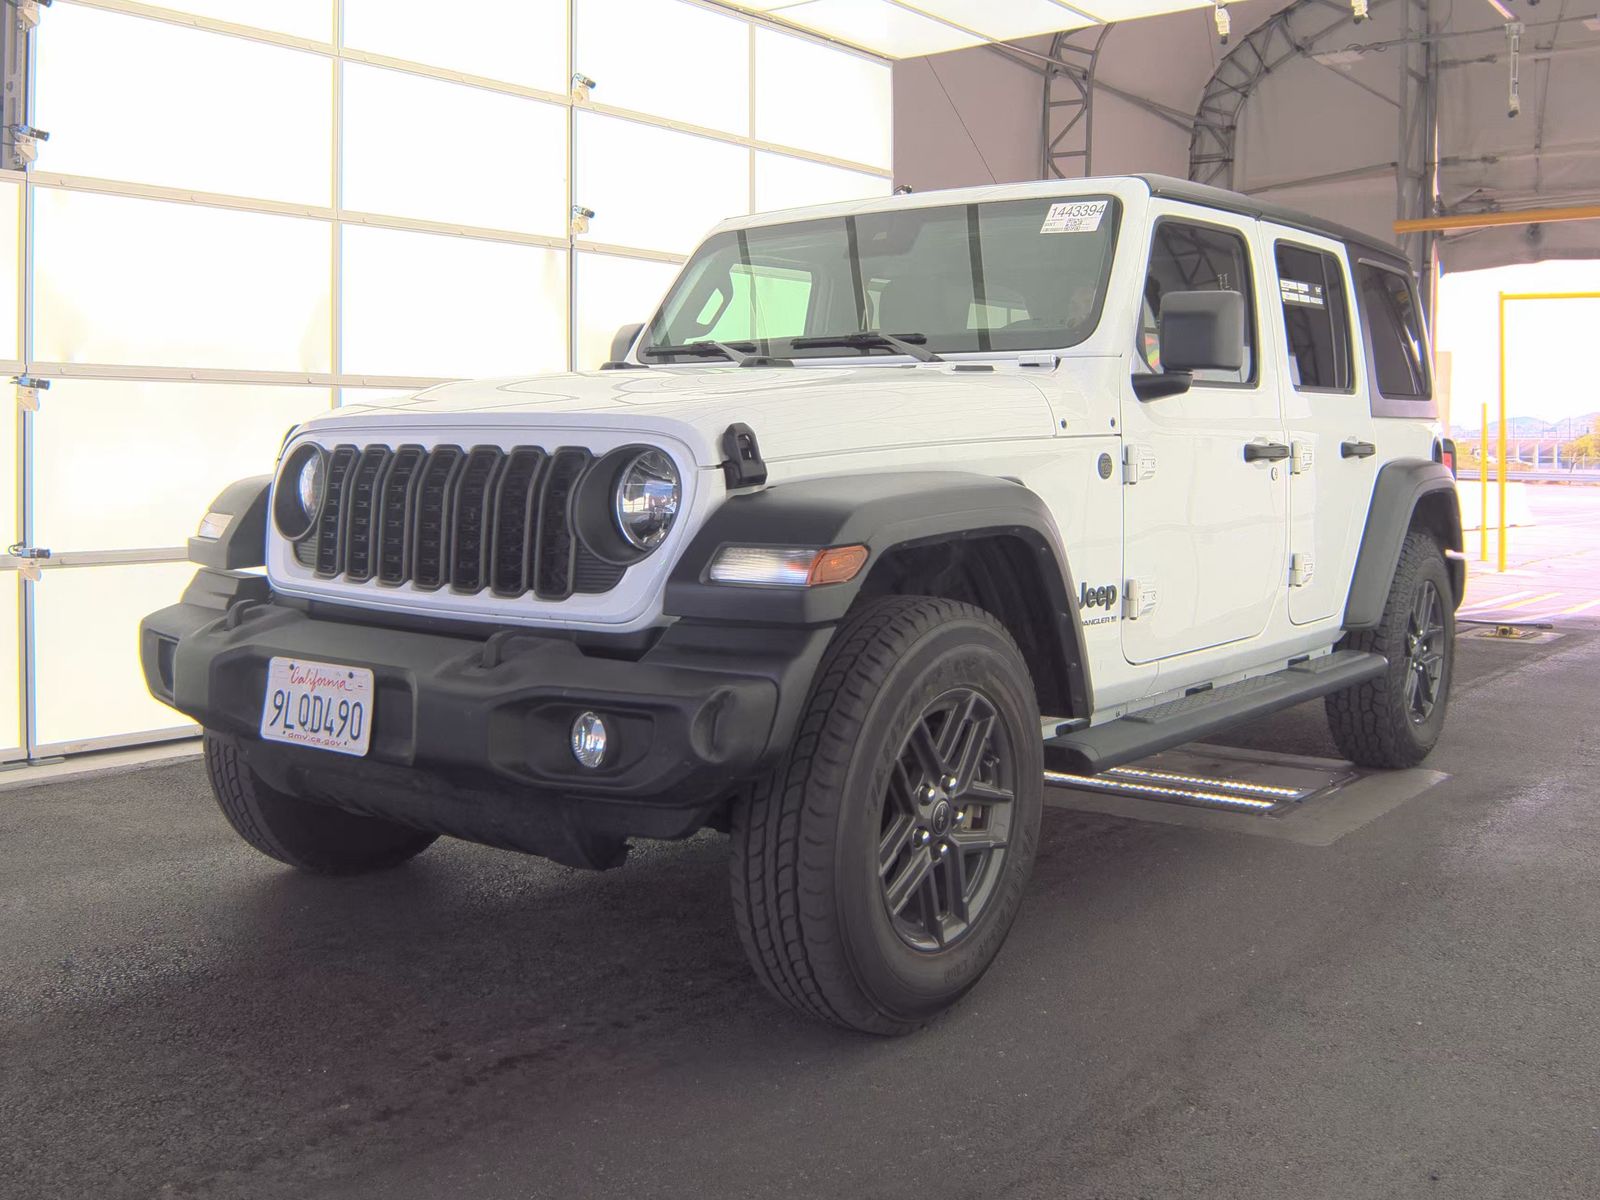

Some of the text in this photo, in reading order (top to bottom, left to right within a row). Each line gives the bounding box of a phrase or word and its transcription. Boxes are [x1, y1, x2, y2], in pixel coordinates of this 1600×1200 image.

[1051, 204, 1106, 218] 1443394
[1079, 581, 1118, 611] Jeep
[1081, 616, 1110, 626] ANGLER
[290, 666, 353, 692] California
[269, 689, 364, 741] 9LQD490
[287, 731, 343, 747] dmv.ca.gov
